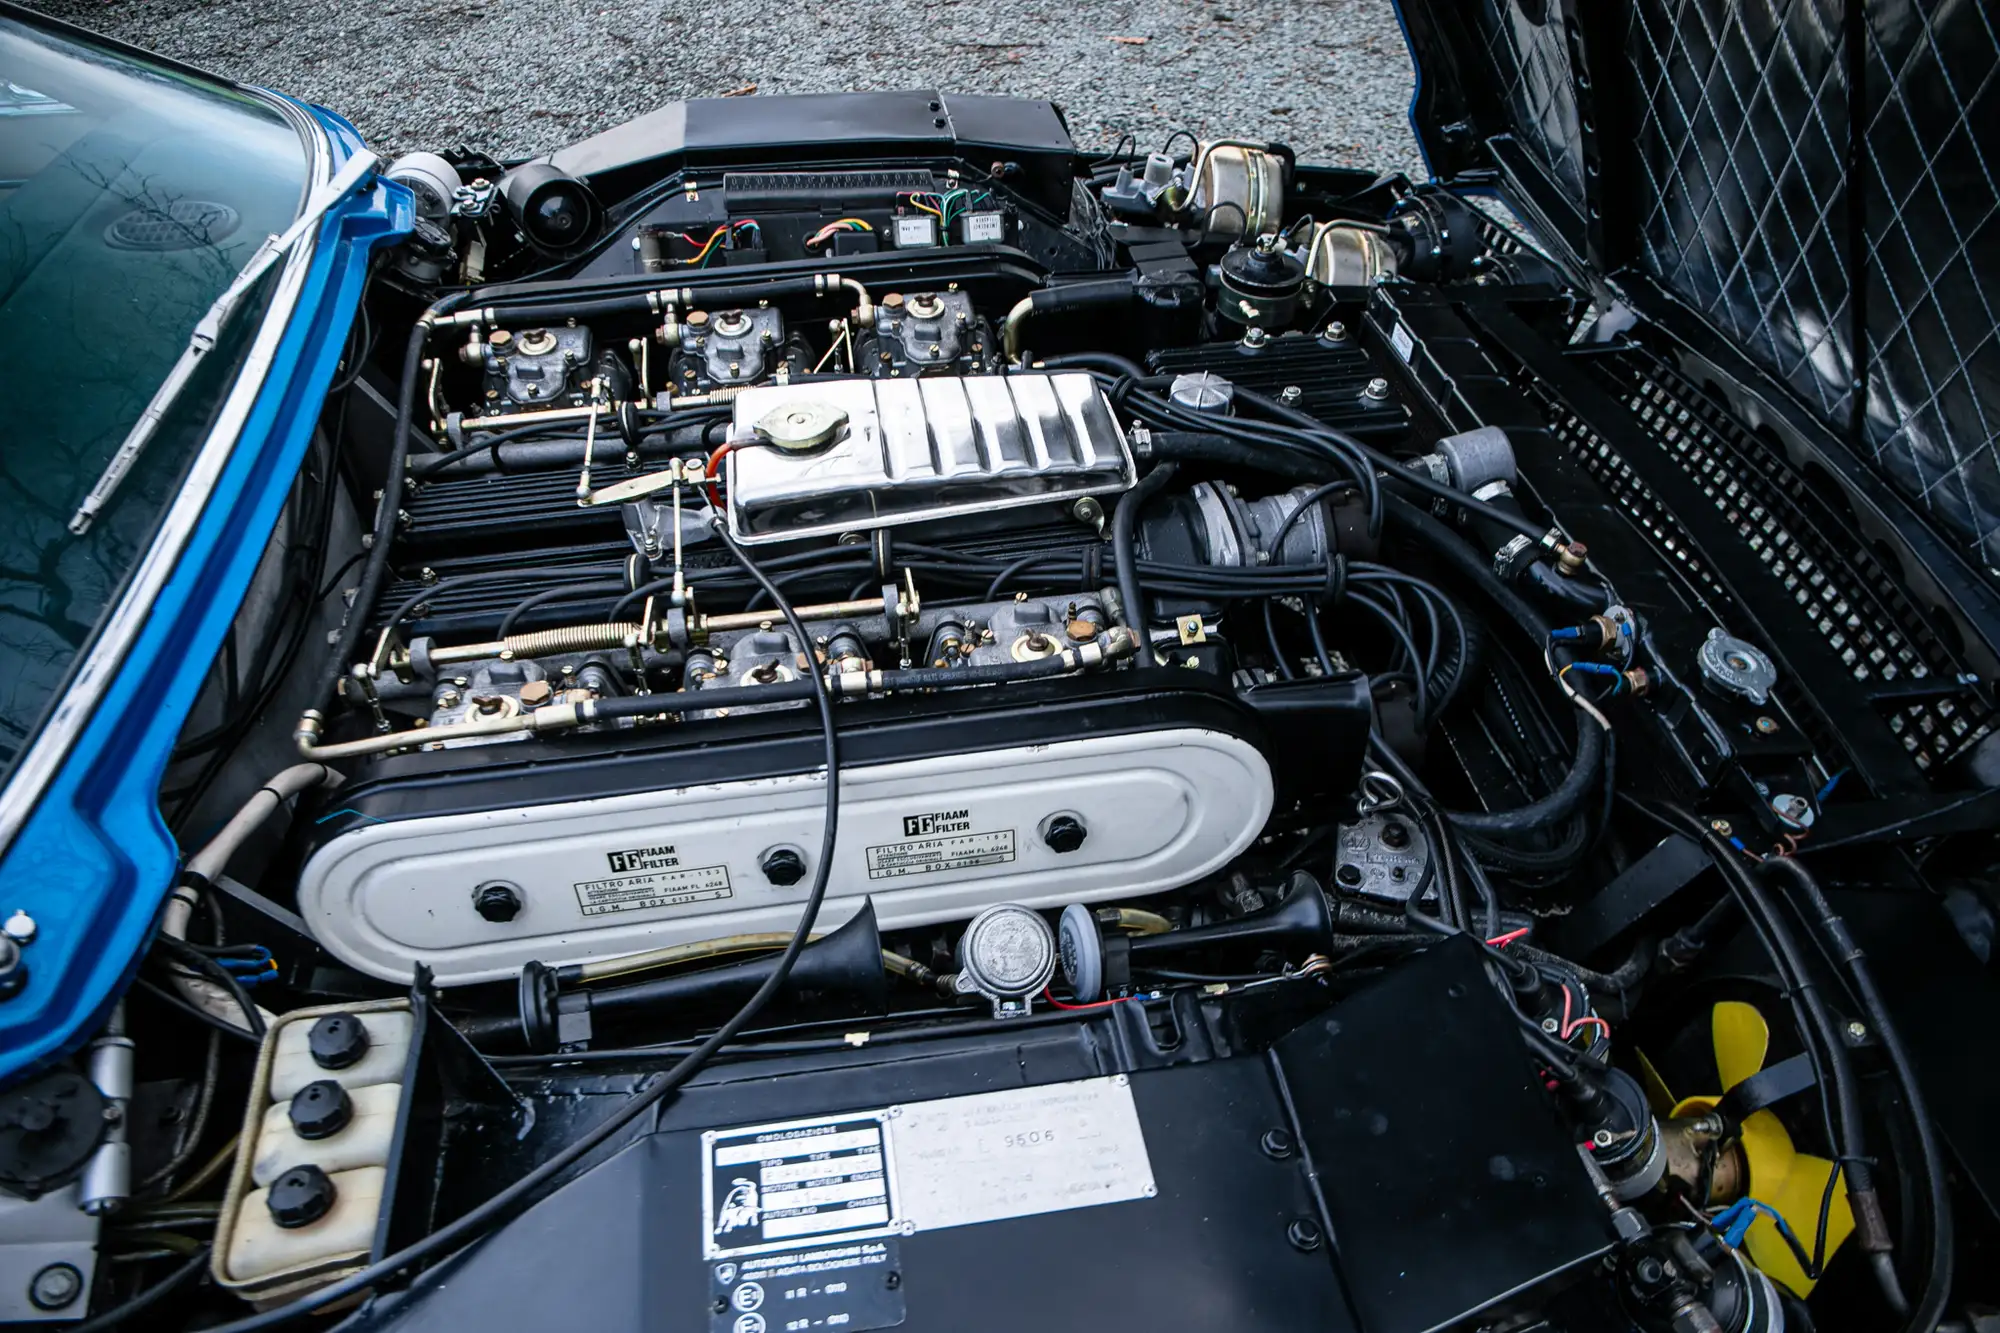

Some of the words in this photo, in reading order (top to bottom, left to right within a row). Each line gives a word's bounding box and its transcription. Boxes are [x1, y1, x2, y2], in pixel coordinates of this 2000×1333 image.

[935, 809, 969, 822] FIAAM
[936, 821, 970, 834] FILTER
[640, 845, 675, 858] FIAAM
[876, 841, 914, 854] FILTRO
[918, 840, 943, 850] ARIA
[951, 849, 975, 857] FIAAM
[642, 857, 679, 870] FILTER
[925, 861, 951, 872] BOX
[585, 880, 624, 891] FILTRO
[628, 877, 655, 886] ARIA
[664, 885, 688, 893] FIAAM
[589, 904, 625, 915] I.G.M.
[639, 899, 666, 908] BOX
[756, 1126, 838, 1143] OMOLOGAZIONE
[1004, 1129, 1055, 1149] 9506
[760, 1158, 784, 1168] TIPO
[761, 1182, 800, 1194] MOTORE
[805, 1176, 844, 1188] MOTEUR
[850, 1170, 884, 1182] ENGINE
[762, 1206, 818, 1220] AUTOTELAIO
[847, 1196, 887, 1209] CHASSIS
[798, 1246, 861, 1262] LAMBORGHINI
